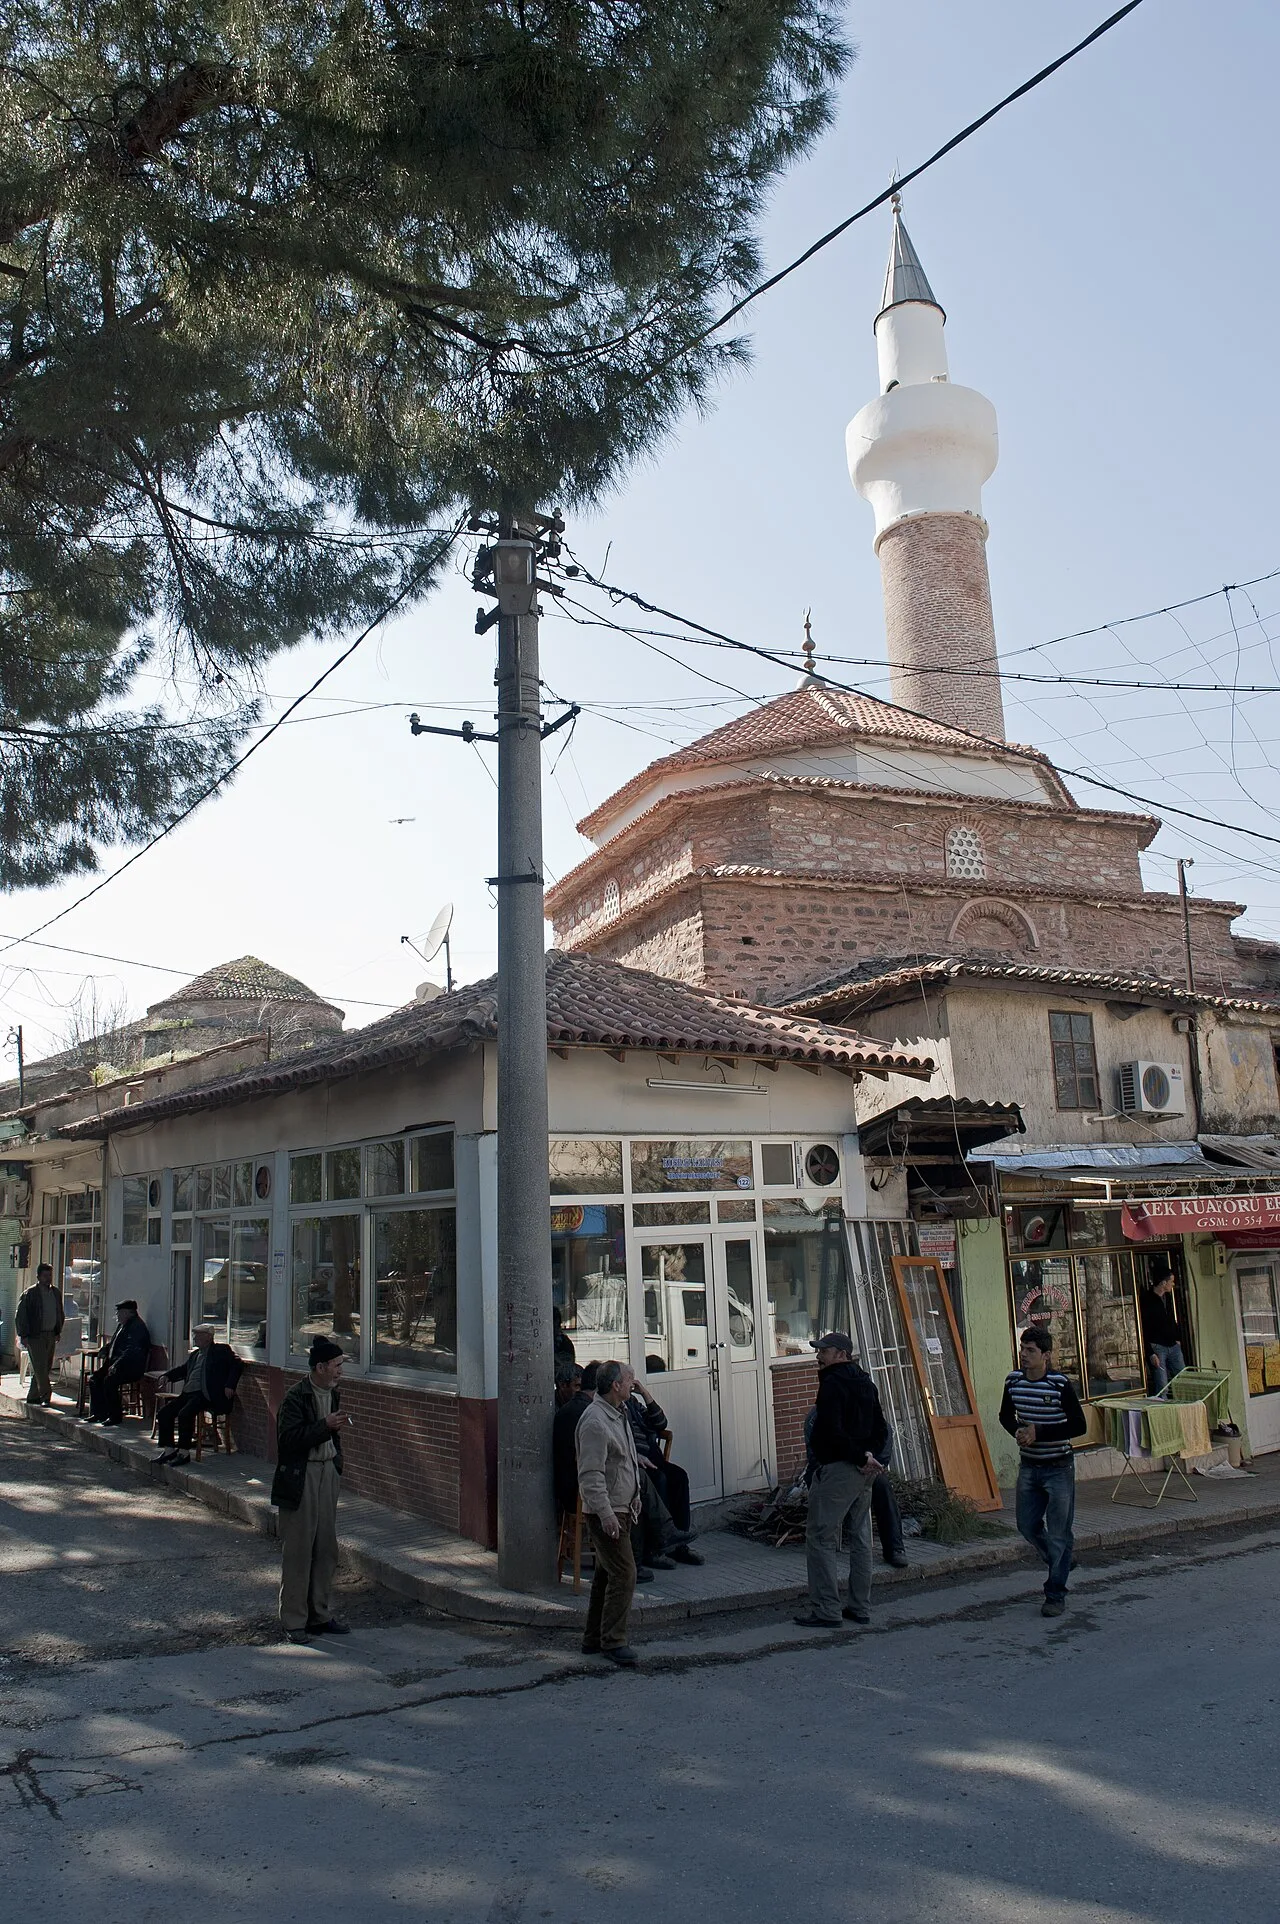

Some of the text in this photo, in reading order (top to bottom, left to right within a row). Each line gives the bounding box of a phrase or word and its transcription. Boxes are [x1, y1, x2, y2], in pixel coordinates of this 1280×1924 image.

[1180, 1196, 1260, 1216] KUAFÖRÜ
[1197, 1217, 1228, 1228] GSM:
[1244, 1216, 1263, 1226] 554
